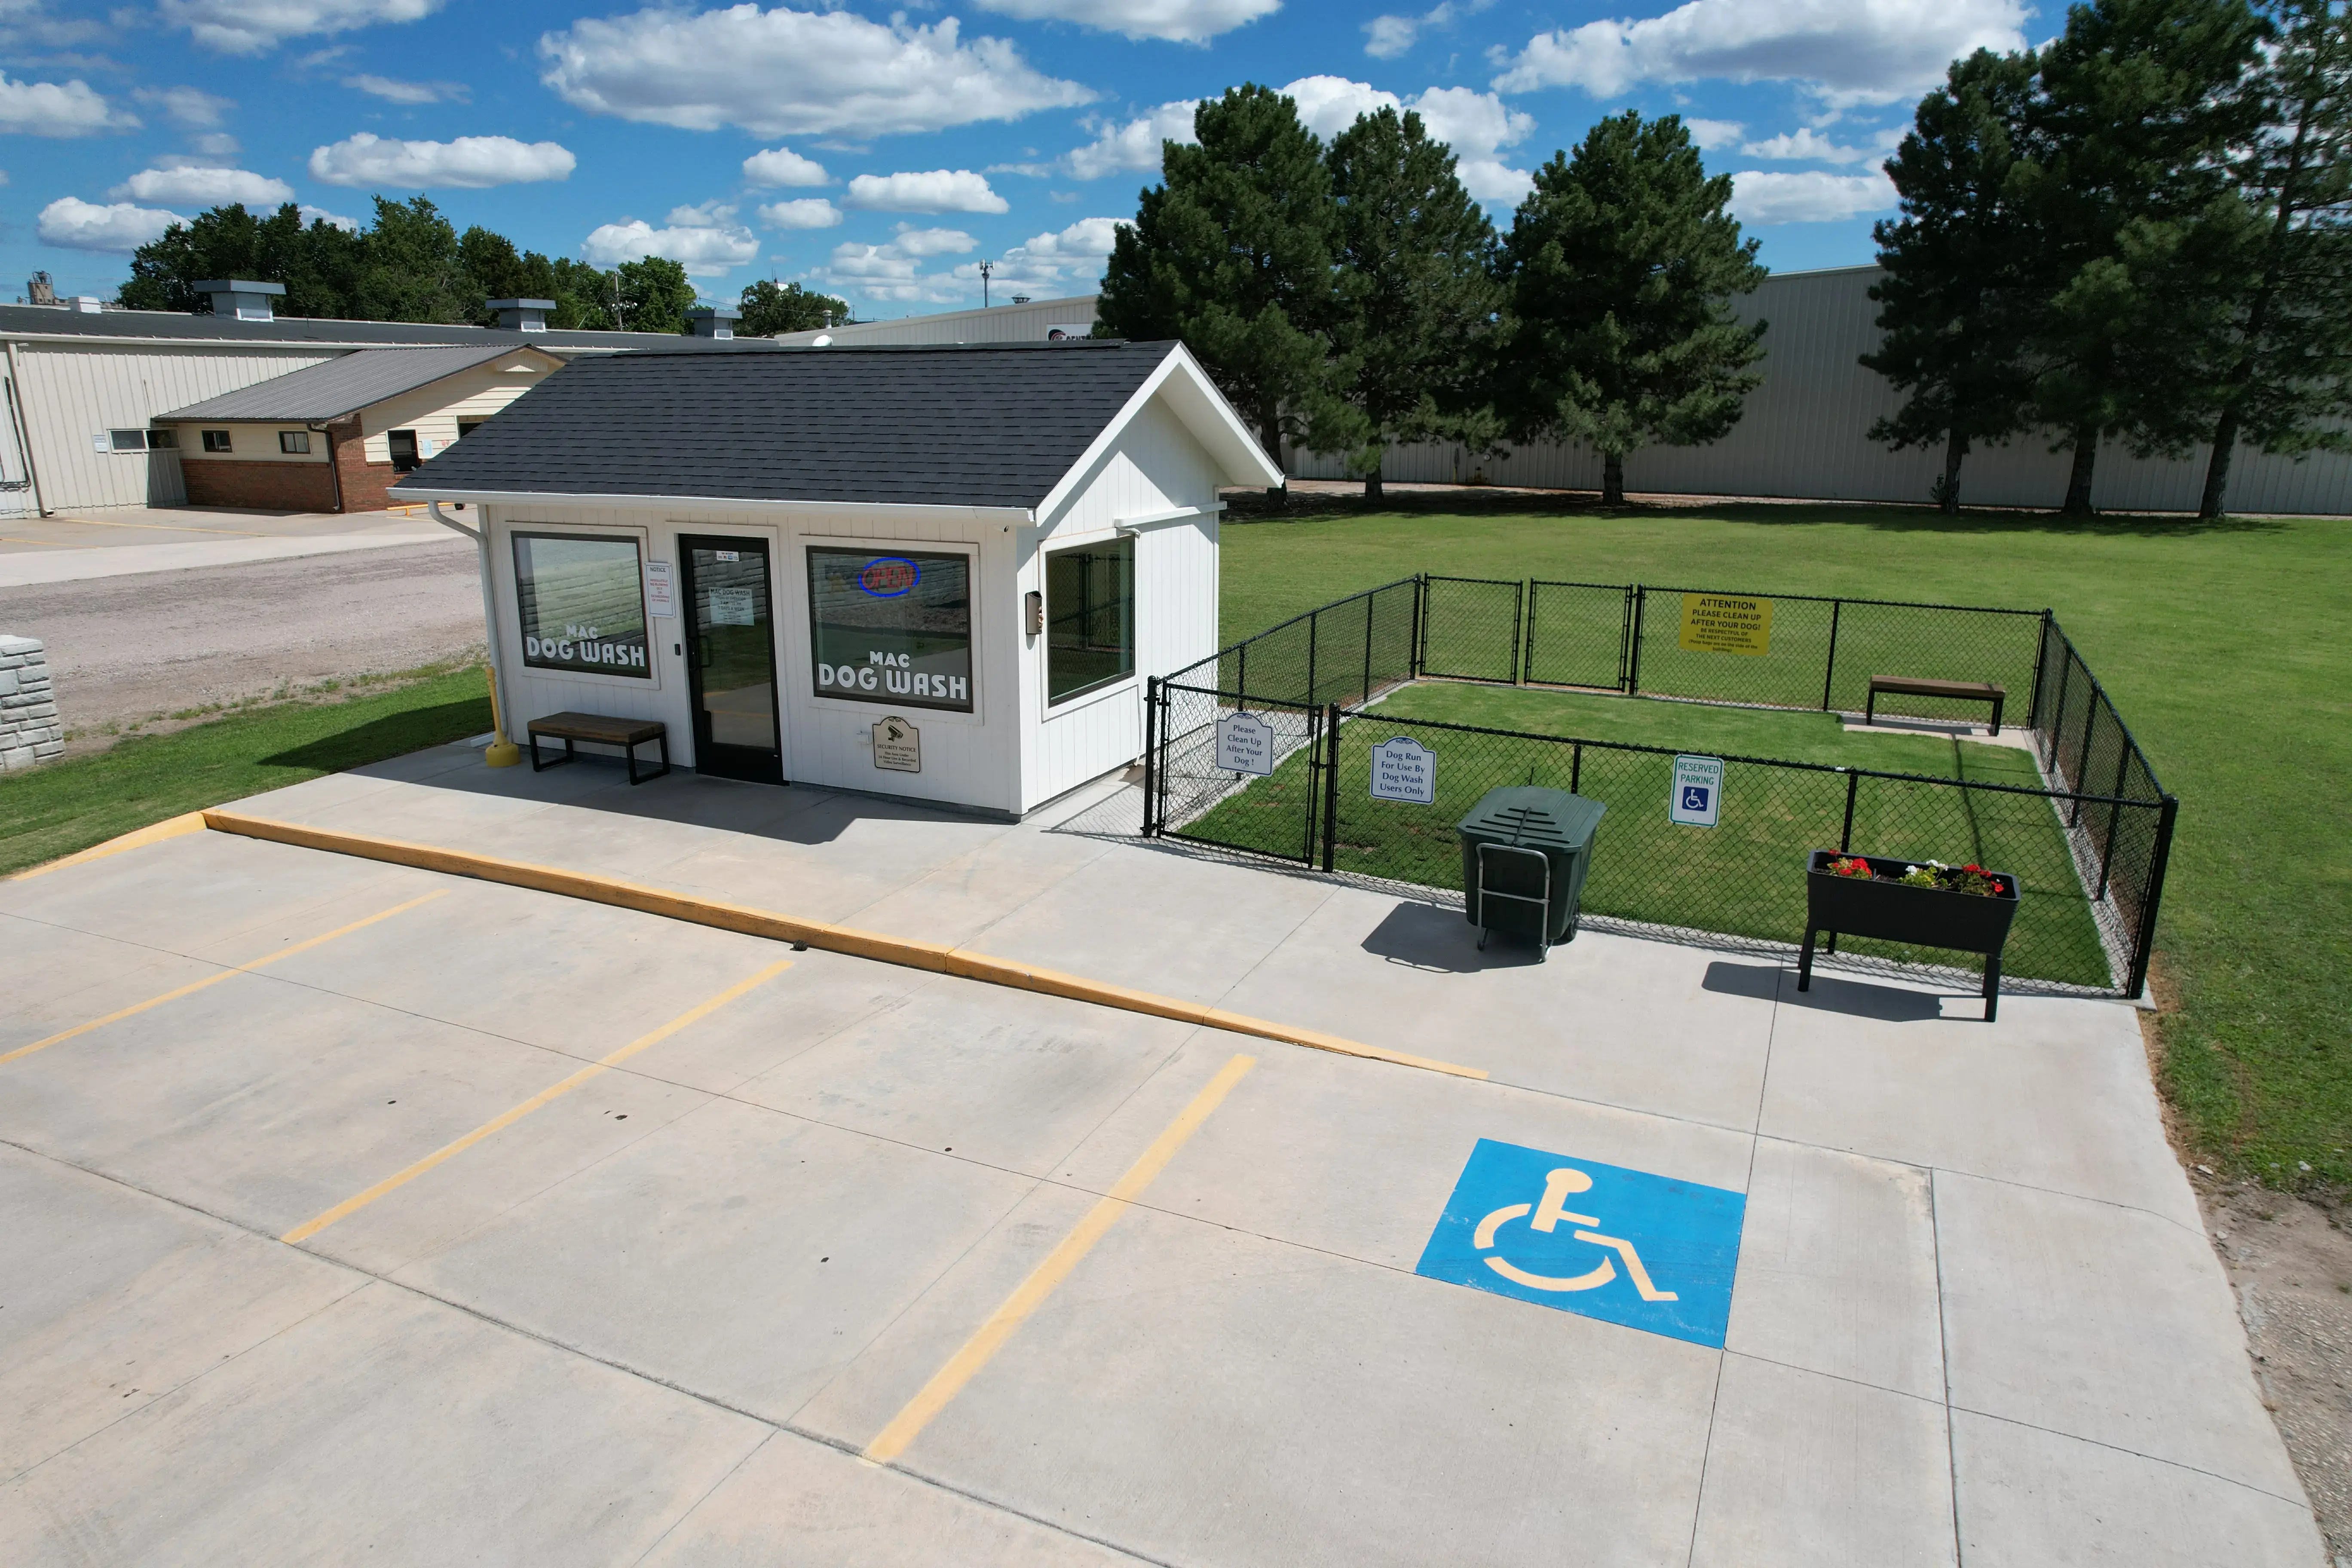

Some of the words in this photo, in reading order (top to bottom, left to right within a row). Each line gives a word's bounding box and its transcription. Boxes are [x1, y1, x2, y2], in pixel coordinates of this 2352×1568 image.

[862, 566, 914, 589] OPEN
[1700, 598, 1756, 610] ATTENTION
[1693, 609, 1721, 618] PLEASE
[1690, 619, 1715, 627] AFTER
[1717, 621, 1739, 629] YOUR
[566, 625, 598, 639] MAC
[526, 637, 574, 660] DOG
[580, 641, 645, 667] WASH
[870, 651, 910, 668] MAC
[818, 663, 877, 690] DOG
[886, 670, 967, 700] WASH
[1233, 724, 1256, 734] Please
[1227, 735, 1248, 743] Clean
[1250, 738, 1262, 747] Up
[1226, 744, 1244, 753] After
[1246, 747, 1263, 756] Your
[1386, 750, 1403, 761] Dog
[1406, 753, 1421, 761] Run
[1234, 756, 1250, 767] Dog
[1397, 763, 1412, 771] Use
[1415, 765, 1425, 775] By
[1678, 762, 1719, 774] RESERVED
[1382, 772, 1399, 783] Dog
[1401, 775, 1423, 784] Wash
[1681, 774, 1714, 785] PARKING
[1380, 783, 1402, 793] Users
[1405, 786, 1424, 797] Only
